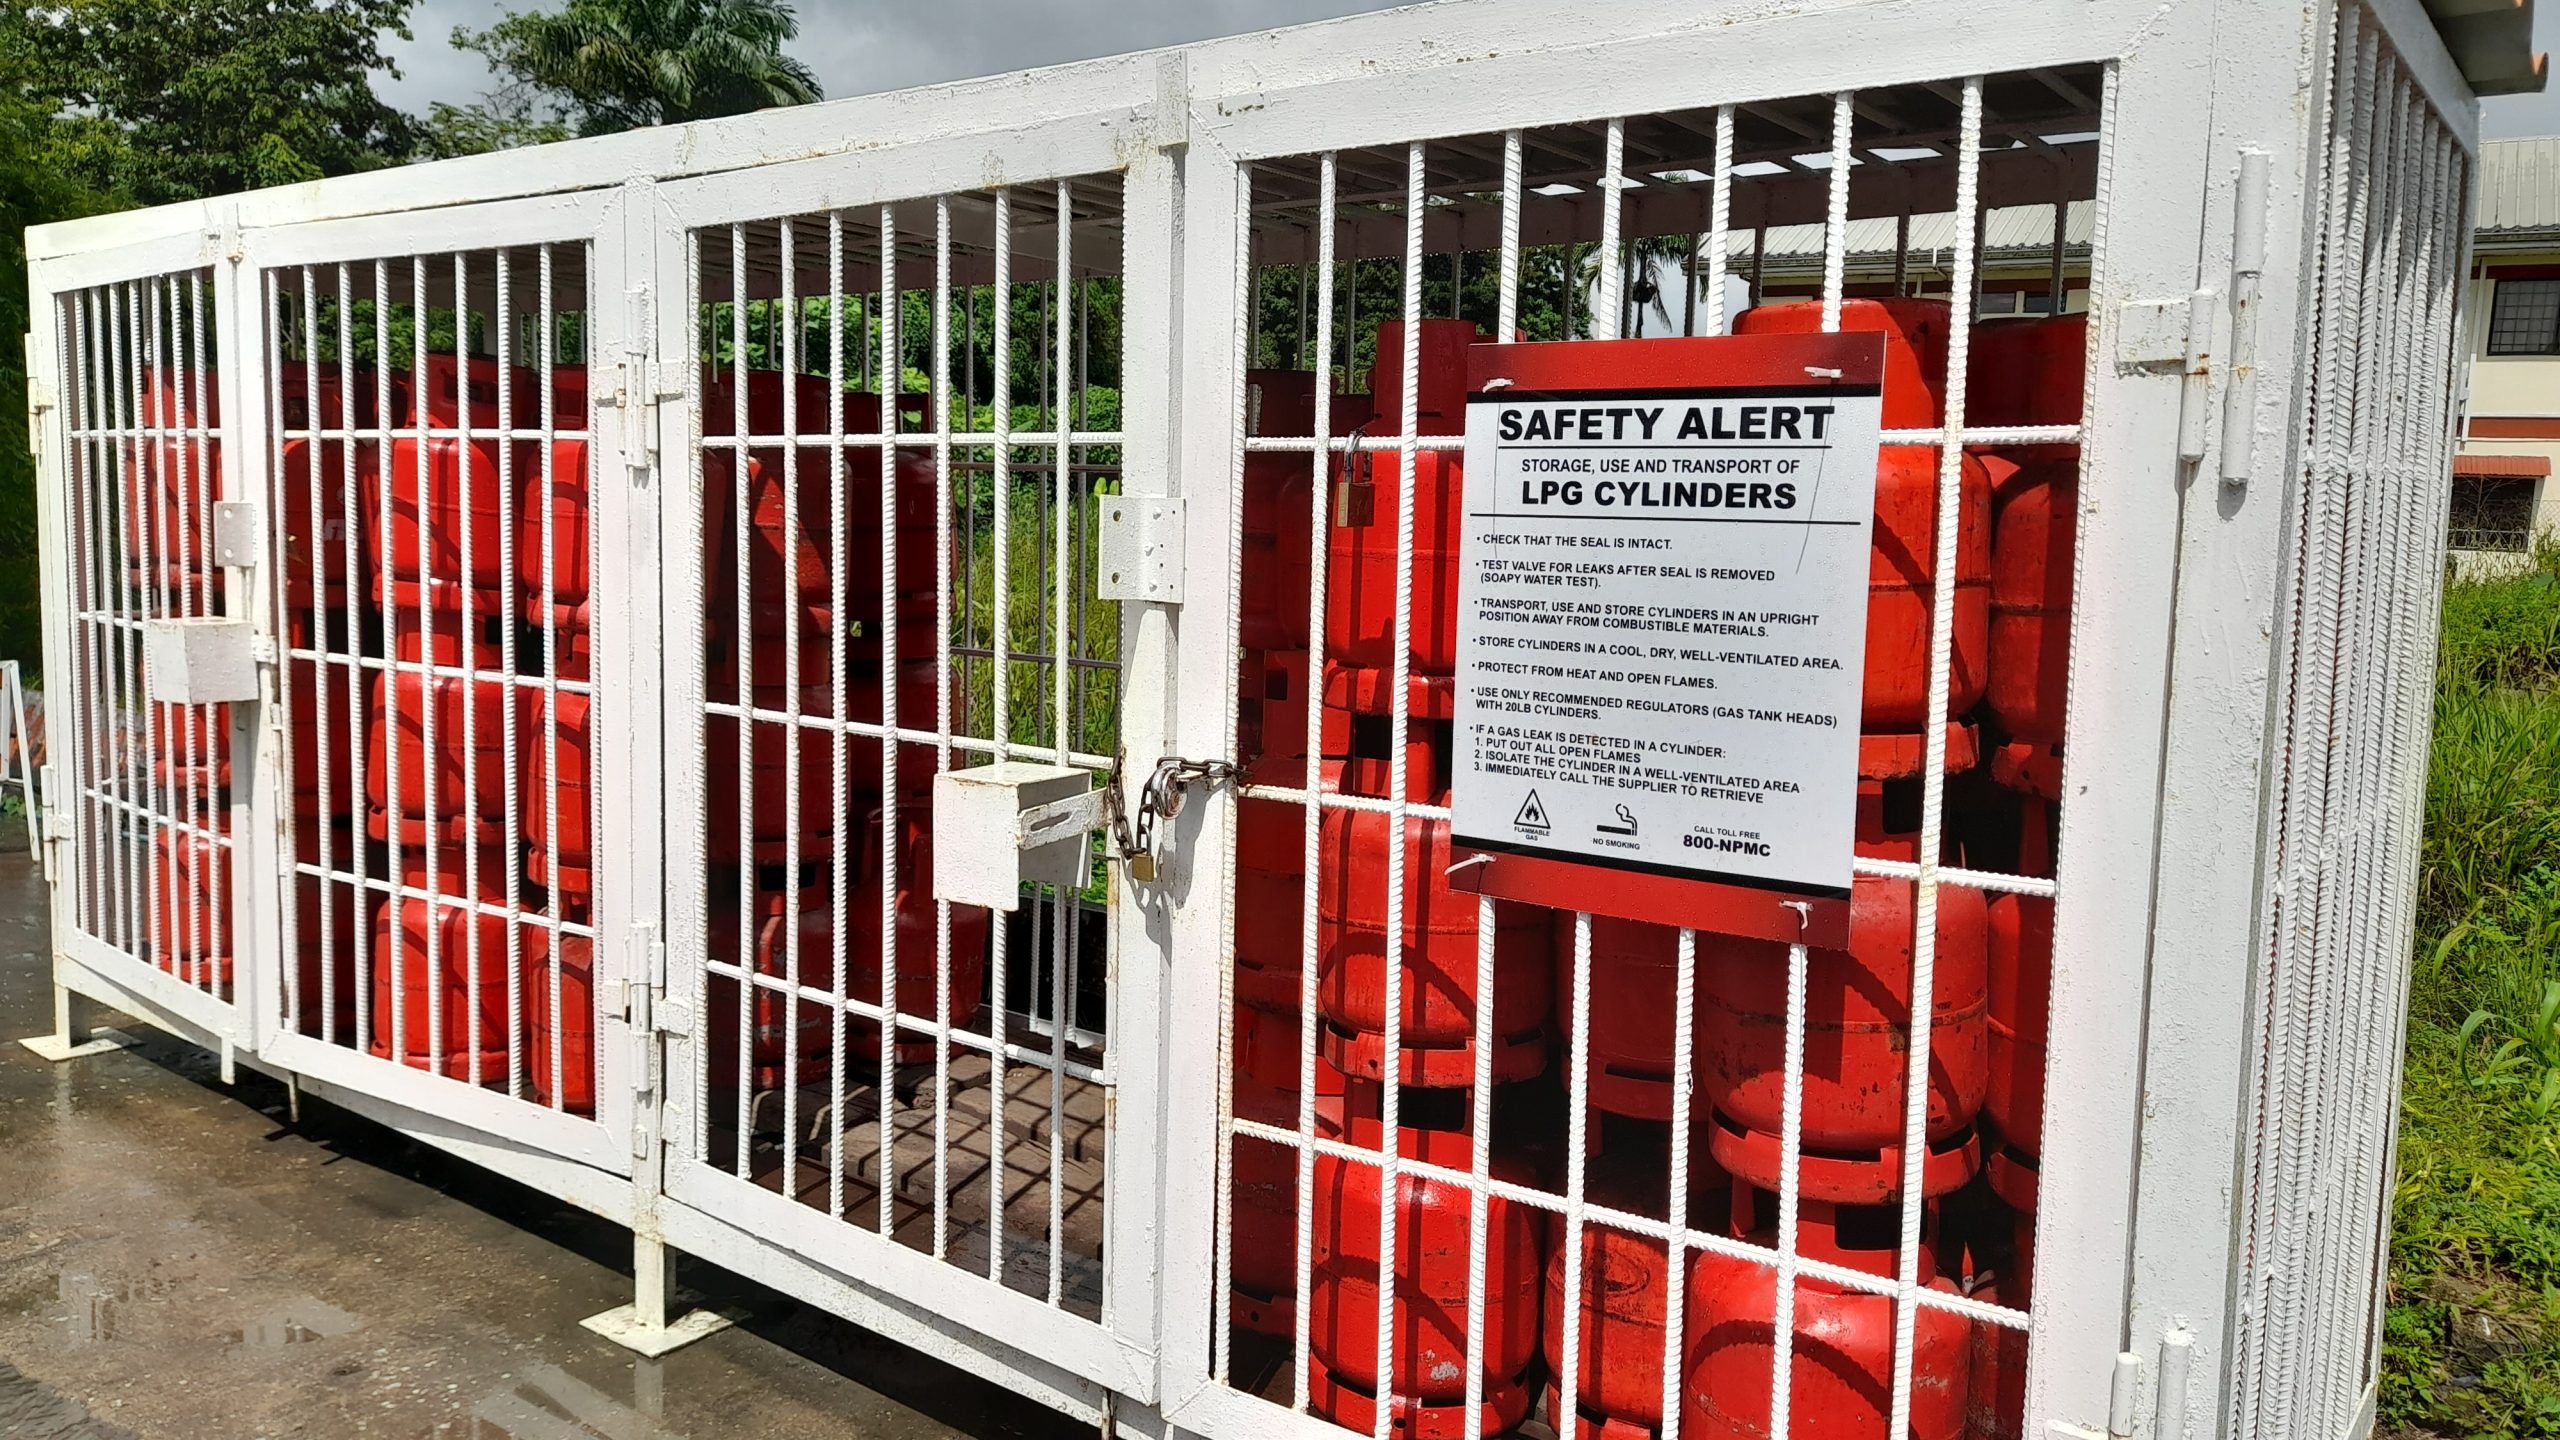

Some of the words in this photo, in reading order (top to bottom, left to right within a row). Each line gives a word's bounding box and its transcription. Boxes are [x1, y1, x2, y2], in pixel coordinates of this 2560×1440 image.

[1499, 408, 1664, 441] SAFETY
[1676, 406, 1834, 439] ALERT
[1521, 459, 1595, 474] STORAGE,
[1600, 459, 1630, 473] USE
[1634, 459, 1667, 473] AND
[1672, 459, 1772, 473] TRANSPORT
[1777, 460, 1800, 474] OF
[1522, 481, 1582, 505] LPG
[1594, 481, 1796, 509] CYLINDERS
[1483, 534, 1521, 544] CHECK
[1524, 535, 1552, 545] THAT
[1555, 536, 1577, 547] THE
[1581, 537, 1611, 548] SEAL
[1614, 538, 1625, 548] IS
[1628, 538, 1672, 550] INTACT.
[1481, 572, 1521, 584] (SOAPY
[1524, 574, 1562, 585] WATER
[1566, 576, 1601, 589] TEST).
[1482, 559, 1509, 570] TEST
[1512, 561, 1546, 572] VALVE
[1549, 562, 1572, 573] FOR
[1576, 563, 1614, 575] LEAKS
[1617, 565, 1656, 576] AFTER
[1660, 566, 1692, 578] SEAL
[1695, 568, 1707, 579] IS
[1711, 568, 1775, 581] REMOVED
[1479, 610, 1529, 623] POSITION
[1532, 614, 1563, 625] AWAY
[1566, 615, 1599, 627] FROM
[1603, 618, 1689, 632] COMBUSTIBLE
[1693, 623, 1768, 637] MATERIALS.
[1481, 598, 1548, 612] TRANSPORT,
[1552, 602, 1574, 612] USE
[1577, 603, 1601, 614] AND
[1605, 604, 1644, 616] STORE
[1648, 607, 1718, 620] CYLINDERS
[1722, 611, 1734, 621] IN
[1738, 611, 1756, 622] AN
[1760, 613, 1820, 626] UPRIGHT
[1479, 636, 1514, 648] STORE
[1518, 638, 1581, 652] CYLINDERS
[1584, 643, 1595, 653] IN
[1598, 644, 1606, 654] A
[1609, 644, 1646, 658] COOL,
[1650, 647, 1676, 660] DRY,
[1680, 649, 1799, 667] WELL-VENTILATED
[1802, 657, 1843, 670] AREA.
[1478, 661, 1528, 674] PROTECT
[1531, 665, 1563, 677] FROM
[1566, 668, 1596, 679] HEAT
[1599, 670, 1624, 682] AND
[1627, 672, 1660, 685] OPEN
[1664, 675, 1717, 689] FLAMES.
[1476, 699, 1502, 710] WITH
[1505, 702, 1531, 713] 20LB
[1534, 704, 1601, 720] CYLINDERS.
[1477, 686, 1498, 698] USE
[1502, 688, 1530, 700] ONLY
[1533, 691, 1623, 708] RECOMMENDED
[1626, 699, 1709, 716] REGULATORS
[1713, 706, 1744, 719] (GAS
[1748, 709, 1782, 722] TANK
[1787, 712, 1837, 729] HEADS)
[1475, 737, 1483, 747] 1.
[1486, 738, 1507, 748] PUT
[1510, 740, 1532, 751] OUT
[1535, 743, 1555, 754] ALL
[1559, 745, 1590, 758] OPEN
[1594, 749, 1640, 763] FLAMES
[1476, 724, 1485, 734] IF
[1487, 725, 1495, 735] A
[1497, 726, 1520, 738] GAS
[1523, 729, 1552, 741] LEAK
[1556, 732, 1566, 742] IS
[1569, 733, 1630, 749] DETECTED
[1634, 740, 1645, 750] IN
[1648, 741, 1657, 752] A
[1660, 742, 1726, 758] CYLINDER:
[1474, 749, 1483, 760] 2.
[1486, 750, 1530, 764] ISOLATE
[1534, 755, 1555, 767] THE
[1558, 758, 1615, 774] CYLINDER
[1619, 765, 1630, 775] IN
[1633, 767, 1641, 777] A
[1645, 768, 1760, 789] WELL-VENTILATED
[1763, 780, 1800, 793] AREA
[1474, 761, 1483, 772] 3.
[1485, 763, 1557, 780] IMMEDIATELY
[1560, 771, 1589, 784] CALL
[1592, 775, 1614, 787] THE
[1618, 778, 1677, 794] SUPPLIER
[1681, 785, 1697, 796] TO
[1701, 787, 1763, 803] RETRIEVE
[1514, 826, 1550, 837] FLAMMABLE
[1606, 839, 1640, 850] SMOKING
[1694, 825, 1714, 834] CALL
[1717, 828, 1736, 836] TOLL
[1739, 831, 1760, 840] FREE
[1683, 834, 1771, 857] 800-NPMC
